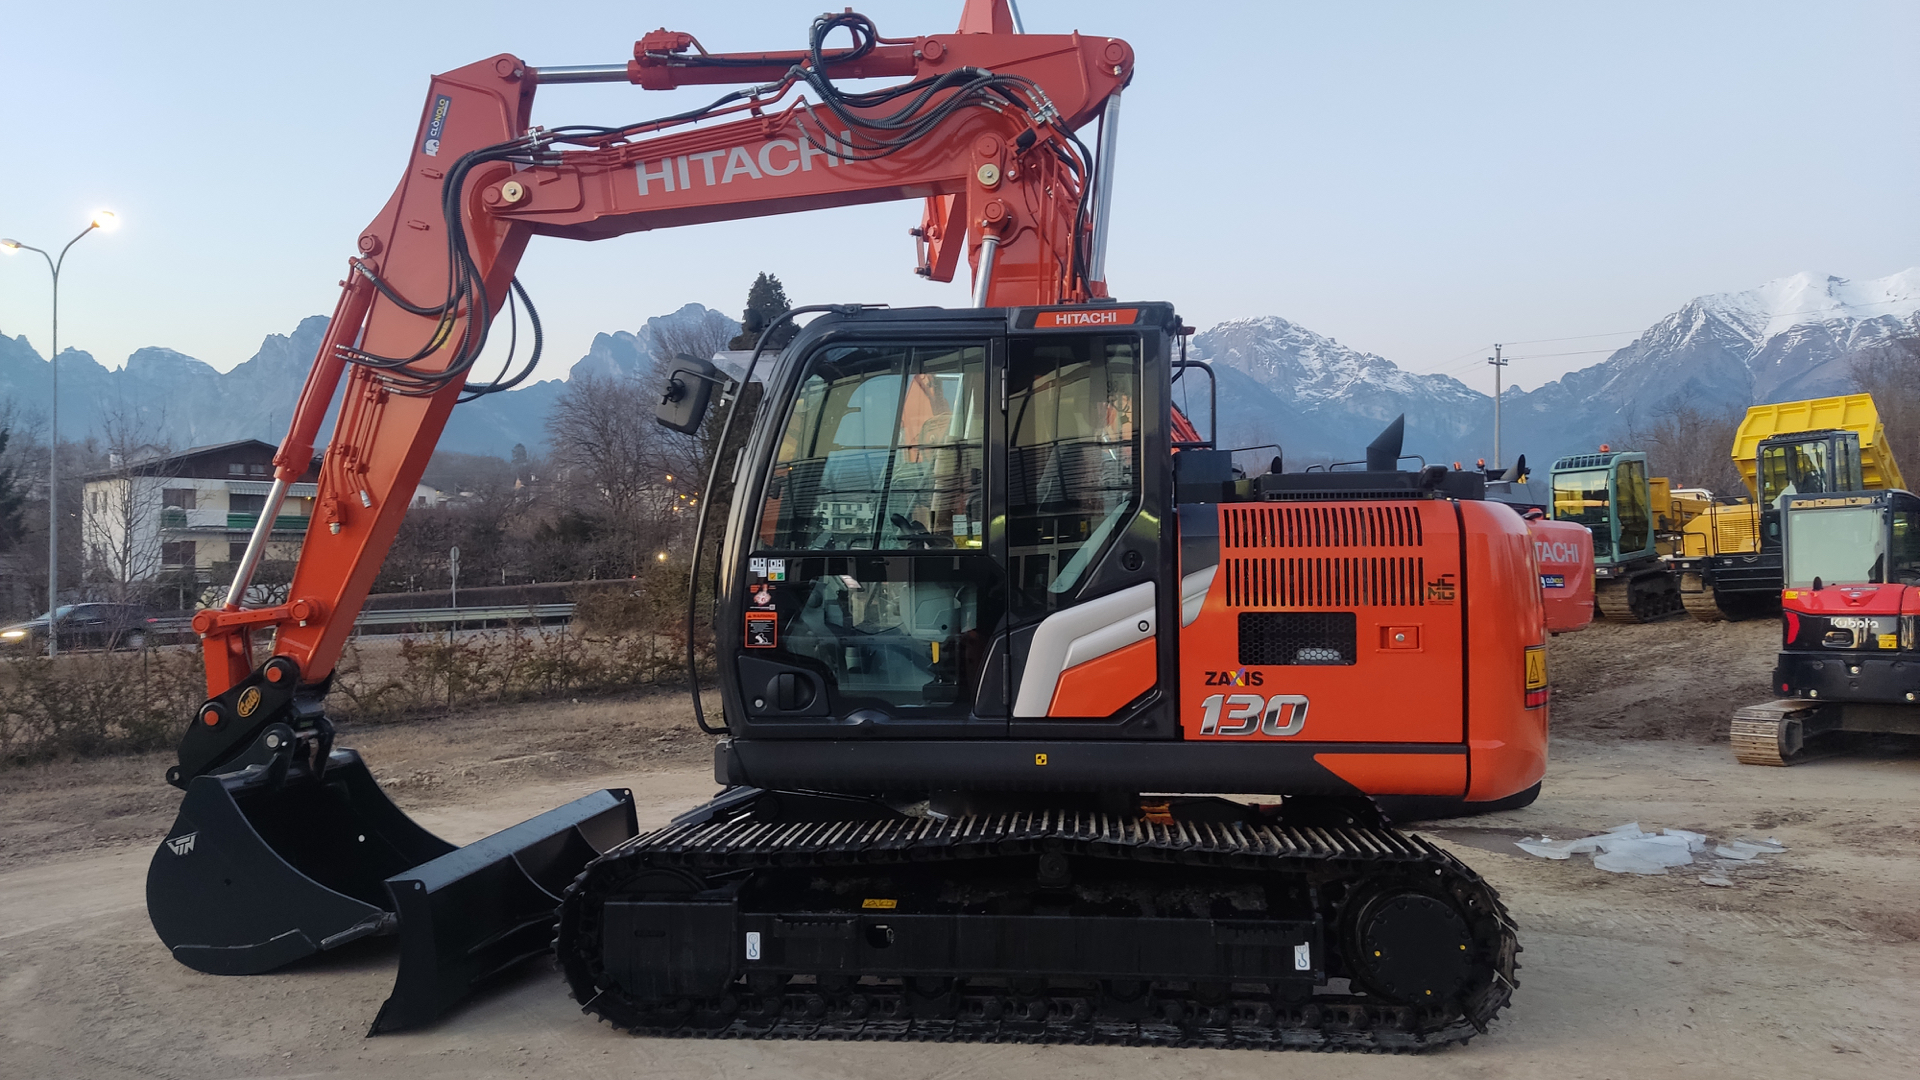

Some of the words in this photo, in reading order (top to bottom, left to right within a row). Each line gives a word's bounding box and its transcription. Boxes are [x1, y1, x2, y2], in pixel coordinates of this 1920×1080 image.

[430, 99, 446, 137] CLÒNOLO
[635, 130, 854, 197] HITACHI
[1055, 312, 1117, 325] HITACHI
[1534, 541, 1580, 563] TACHI
[1830, 617, 1879, 629] Kubota
[1204, 667, 1264, 687] ZAXIS
[1199, 694, 1310, 736] 130
